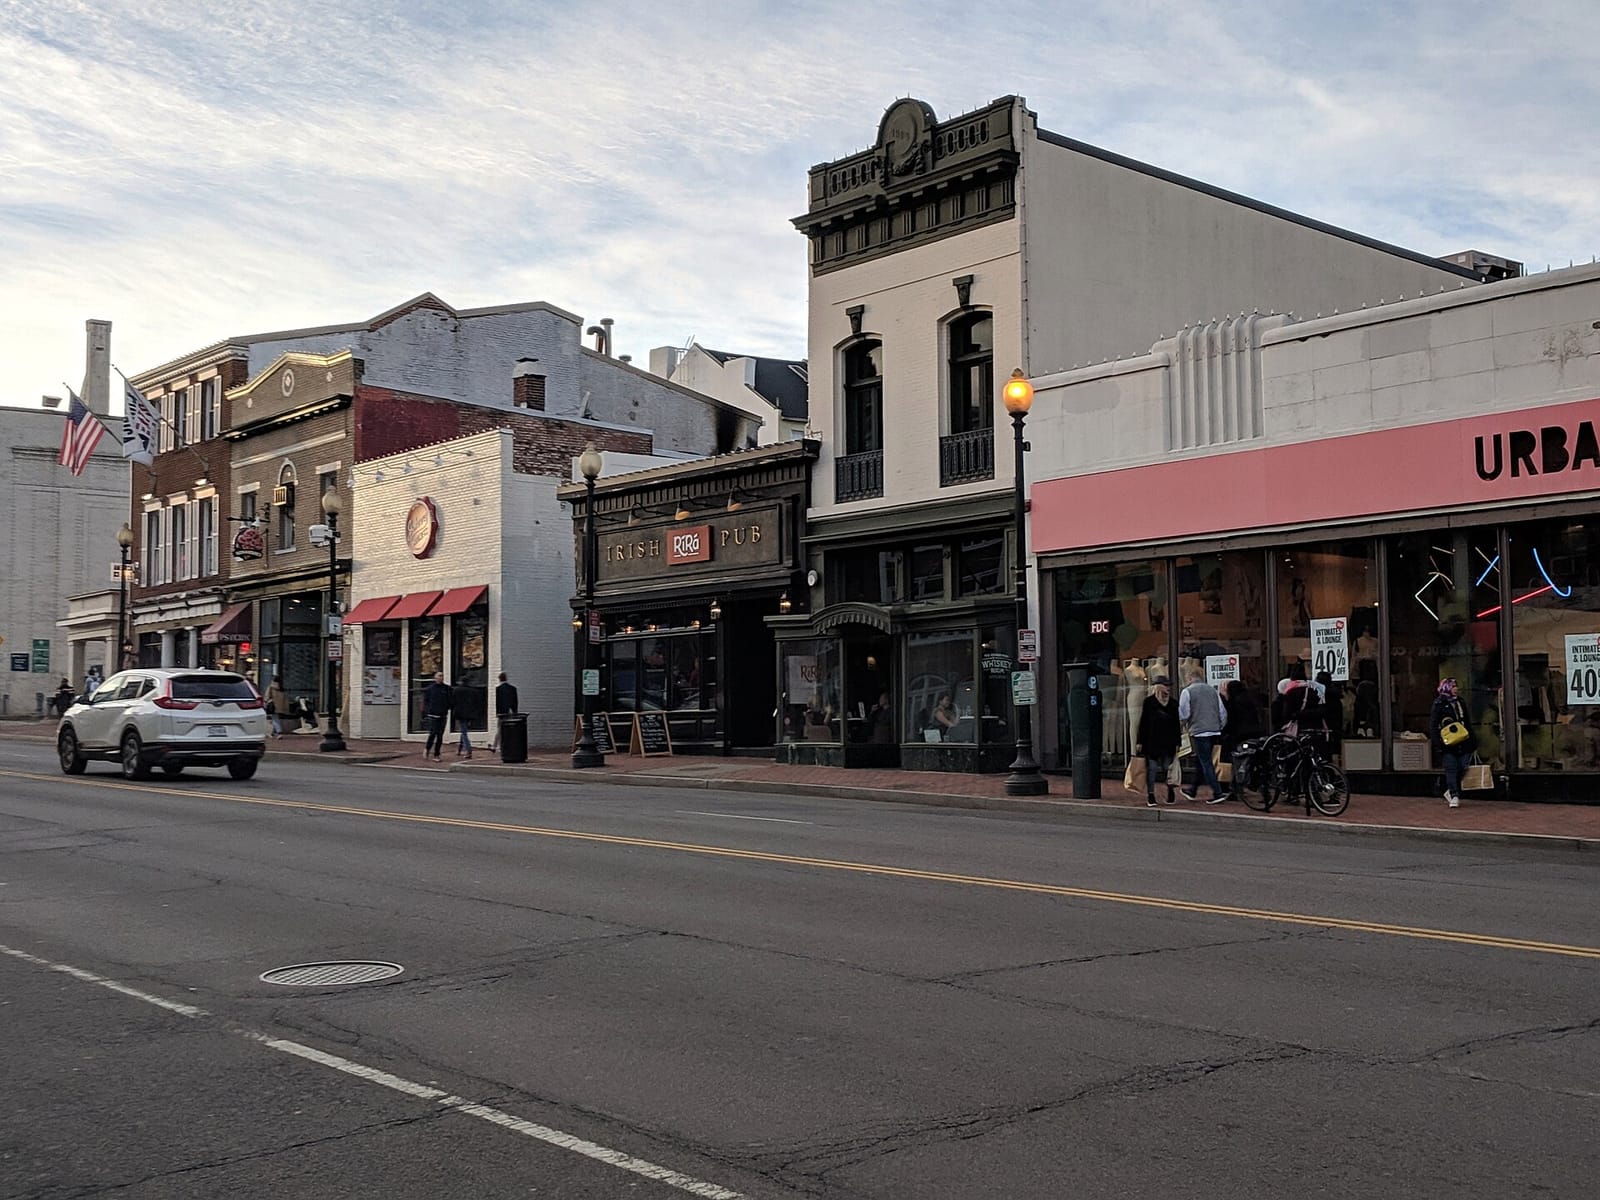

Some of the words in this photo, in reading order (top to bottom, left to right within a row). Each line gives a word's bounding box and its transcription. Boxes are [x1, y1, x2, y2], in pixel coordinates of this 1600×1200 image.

[1474, 421, 1600, 481] URBA
[673, 533, 700, 557] RíRá
[721, 525, 762, 547] PUB
[607, 539, 660, 562] IRISH
[1091, 621, 1109, 633] FDC
[982, 660, 1012, 669] WHISKEY
[1315, 649, 1346, 674] 40%
[1570, 668, 1600, 698] 40
